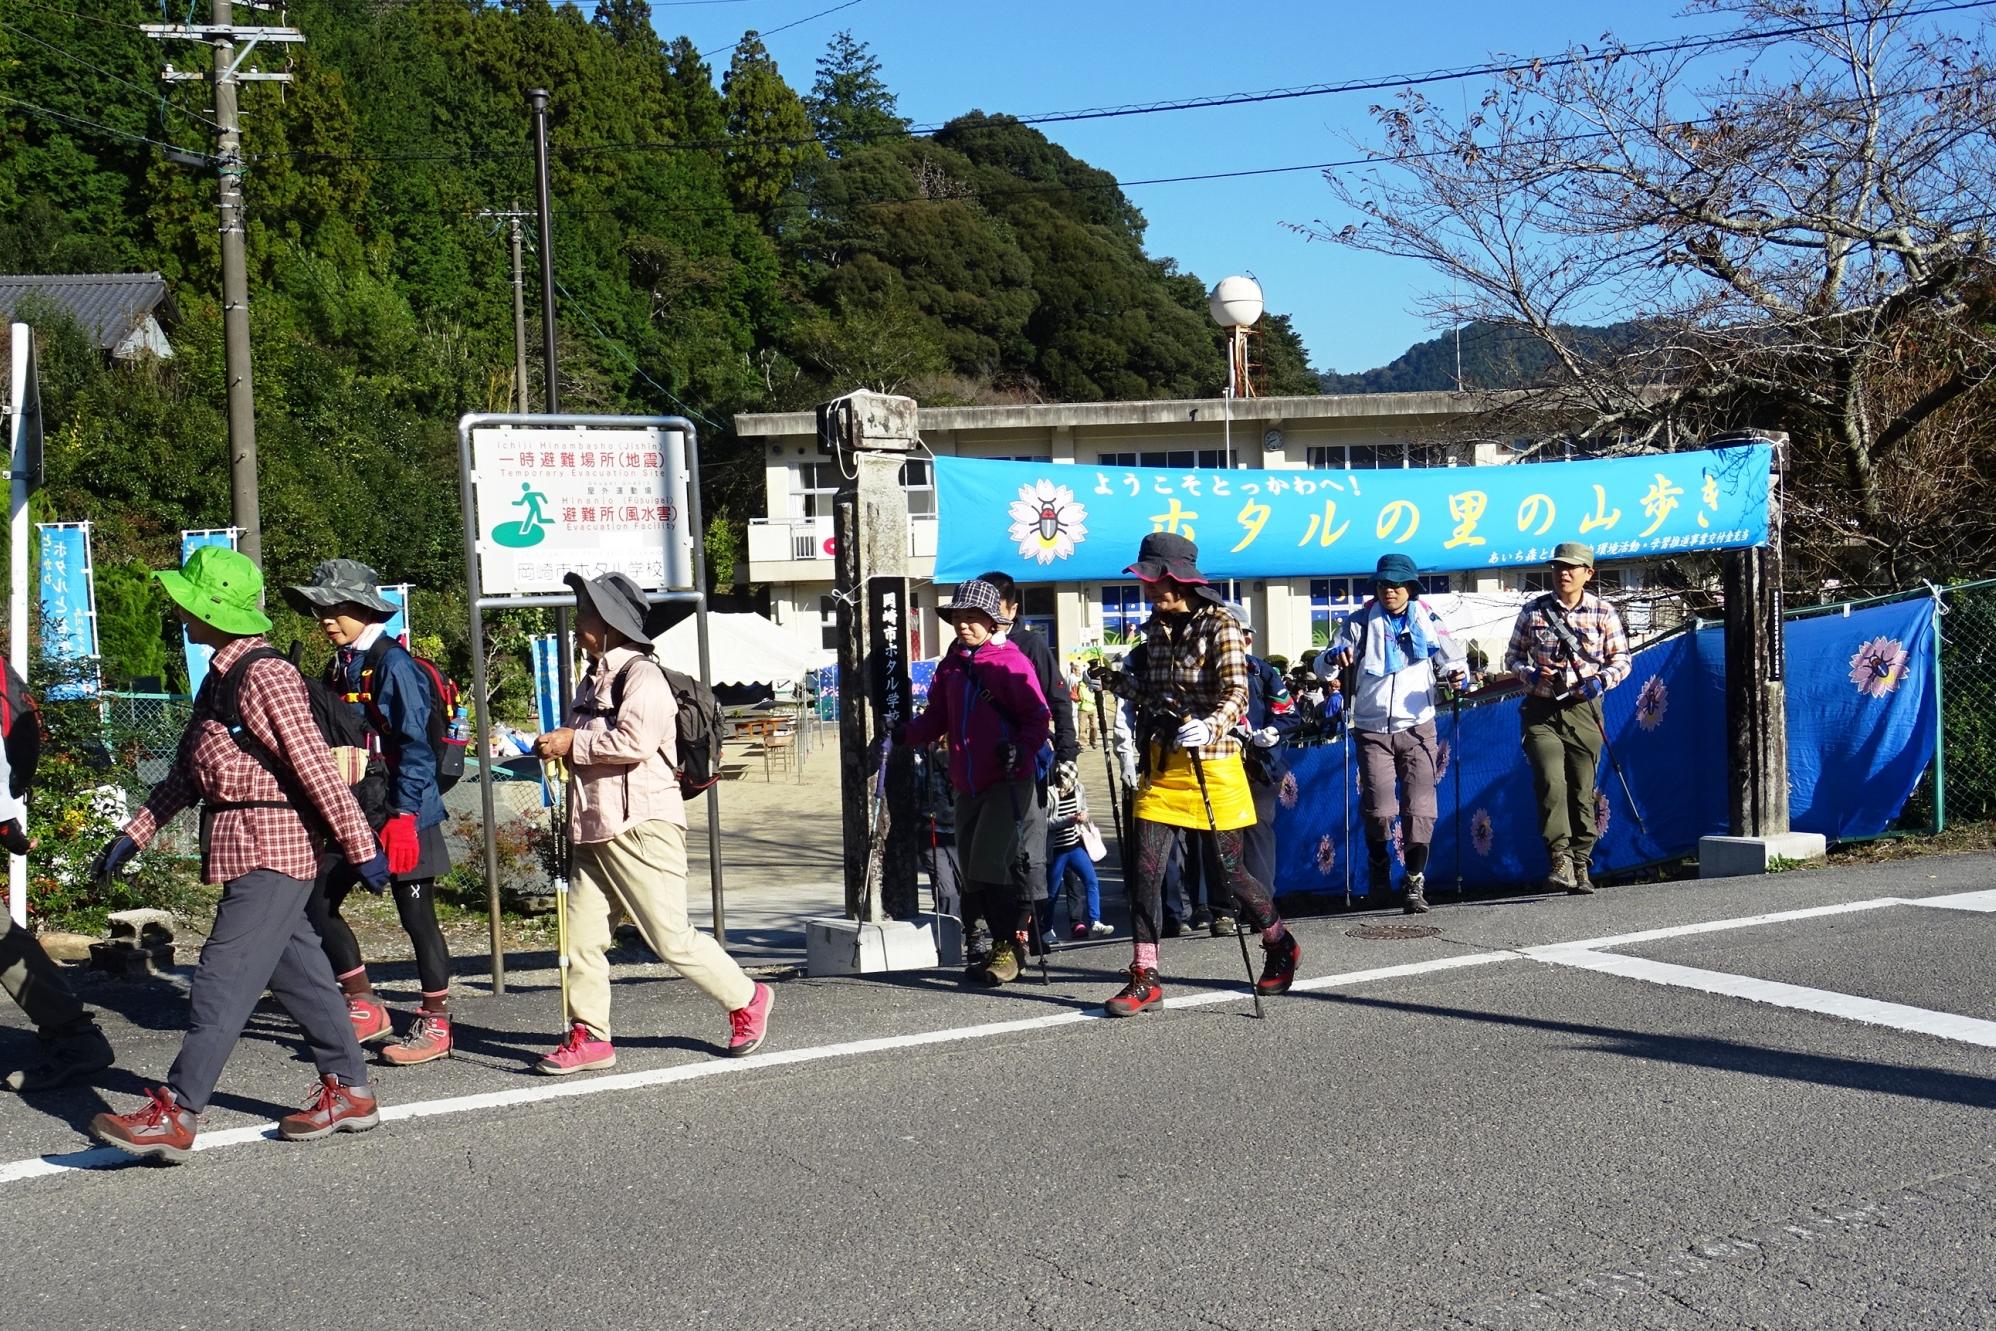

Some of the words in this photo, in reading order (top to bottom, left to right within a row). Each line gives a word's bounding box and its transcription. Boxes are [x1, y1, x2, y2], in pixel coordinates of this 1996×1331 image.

[540, 441, 614, 450] Hinambasho
[498, 451, 666, 468] 一時避難場所(地震)
[500, 468, 564, 478] Temporary
[571, 468, 636, 477] Evacuation
[643, 468, 666, 477] Site
[1094, 472, 1361, 497] ようこそとっかわへ!
[562, 496, 614, 505] Hinanjo
[562, 505, 678, 522] 避難所(風水害)
[1148, 473, 1719, 553] ホタルの里の山歩き
[567, 523, 628, 531] Evacuation
[634, 522, 676, 531] Facility
[517, 561, 663, 580] 岡崎市ホタル学校
